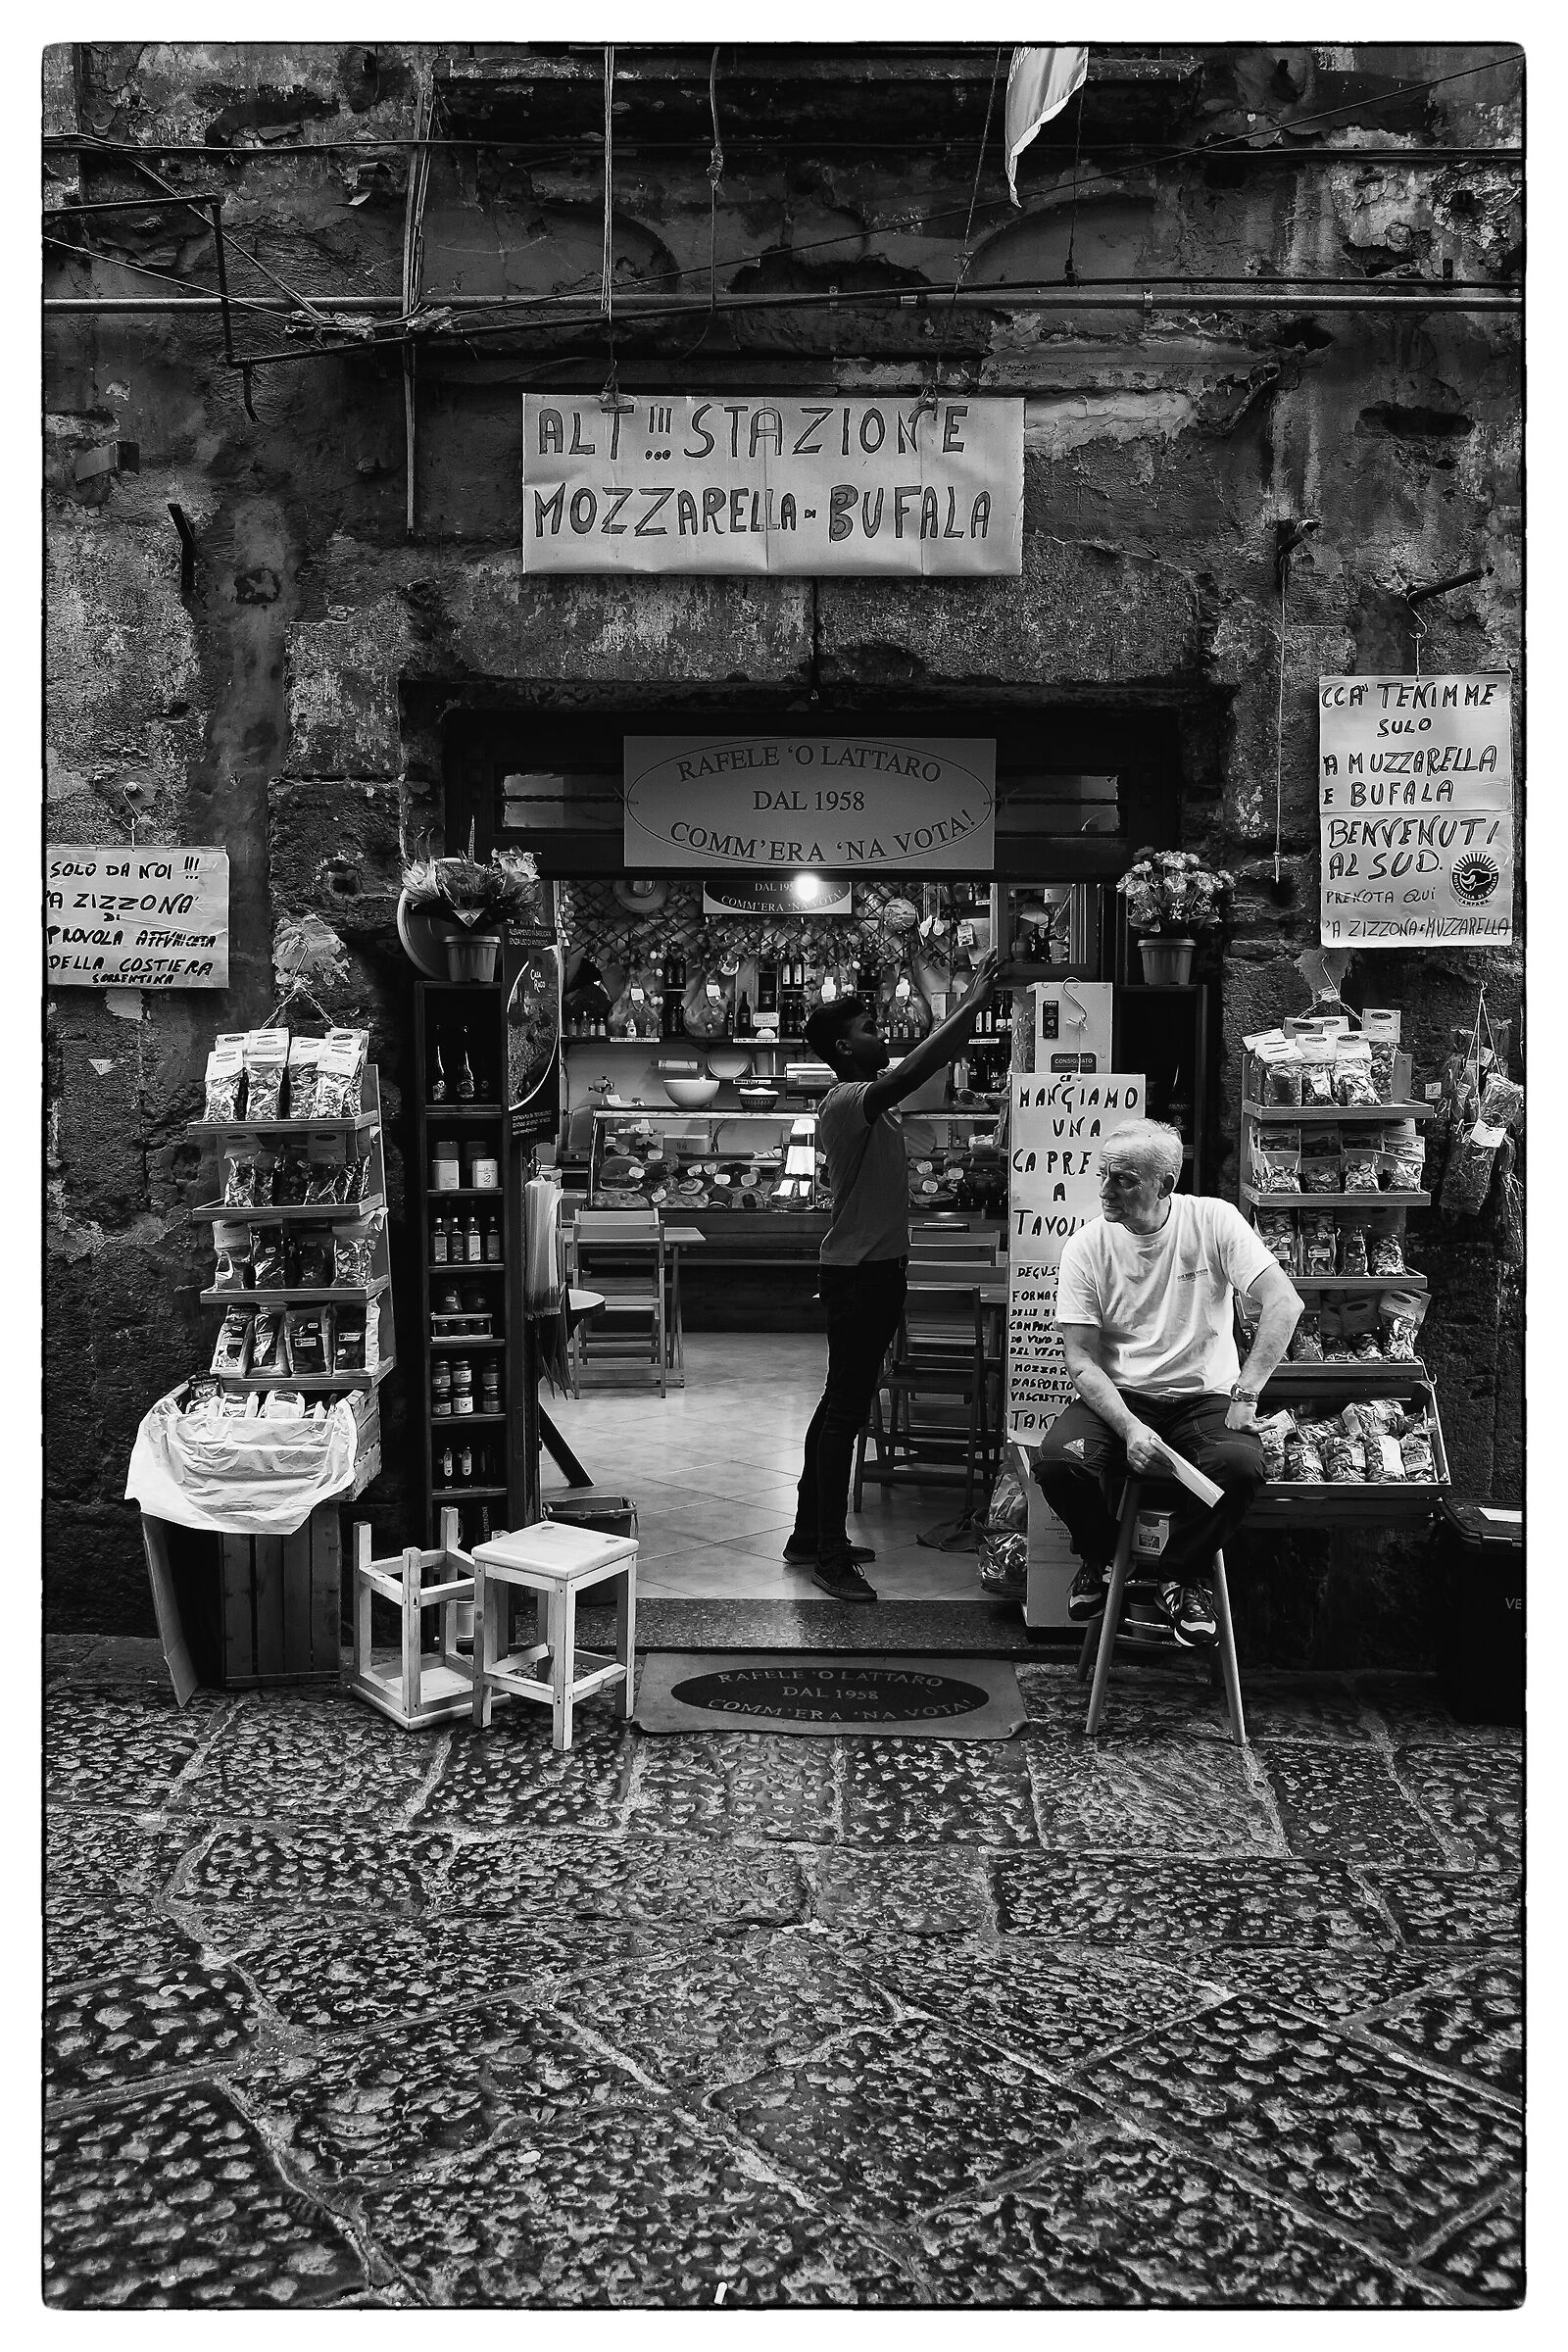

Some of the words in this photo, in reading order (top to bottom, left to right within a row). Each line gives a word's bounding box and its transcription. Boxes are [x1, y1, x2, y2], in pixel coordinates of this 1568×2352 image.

[539, 404, 634, 460] ALT
[684, 403, 969, 458] STAZIONE
[534, 482, 797, 538] MOZZARELLA
[829, 484, 992, 543] BUFALA
[1377, 682, 1497, 709] TENIMME
[1377, 717, 1432, 737] SULO
[676, 746, 780, 783] RAFELE
[821, 746, 942, 783] LATTARO
[1348, 746, 1497, 776] MUZZARELLA
[753, 790, 808, 811] DAL
[814, 790, 865, 811] 1958
[1350, 779, 1453, 807] BUFALA
[669, 821, 826, 862] COMM'ERA
[836, 839, 886, 861] 'NA
[893, 808, 976, 854] VOTA!
[1328, 814, 1499, 849] BENVENUTI
[49, 860, 97, 879] SOLO
[105, 861, 131, 877] DA
[138, 861, 172, 880] NOI
[1329, 852, 1359, 880] AL
[755, 882, 777, 892] DAL
[779, 882, 796, 892] 195
[1326, 889, 1395, 906] PRENOTA
[720, 895, 784, 912] COMM'ERA
[47, 925, 124, 946] PROVOLA
[1348, 918, 1418, 938] ZIZZONA
[1424, 916, 1510, 939] MUZZARELLA
[48, 955, 105, 971] DELLA
[119, 957, 215, 977] COSTIERA
[1019, 1083, 1139, 1115] MANGIAMO
[1053, 1116, 1102, 1138] UNA
[1012, 1148, 1100, 1177] CAPRE
[1053, 1181, 1066, 1202] A
[1016, 1264, 1059, 1280] DEGUS
[1009, 1347, 1029, 1355] DEL
[1011, 1378, 1074, 1391] D'ASPORTO
[717, 1670, 805, 1685] RAFELE
[841, 1670, 944, 1688] LATTARO
[783, 1686, 828, 1698] DAL
[835, 1689, 879, 1700] 1958
